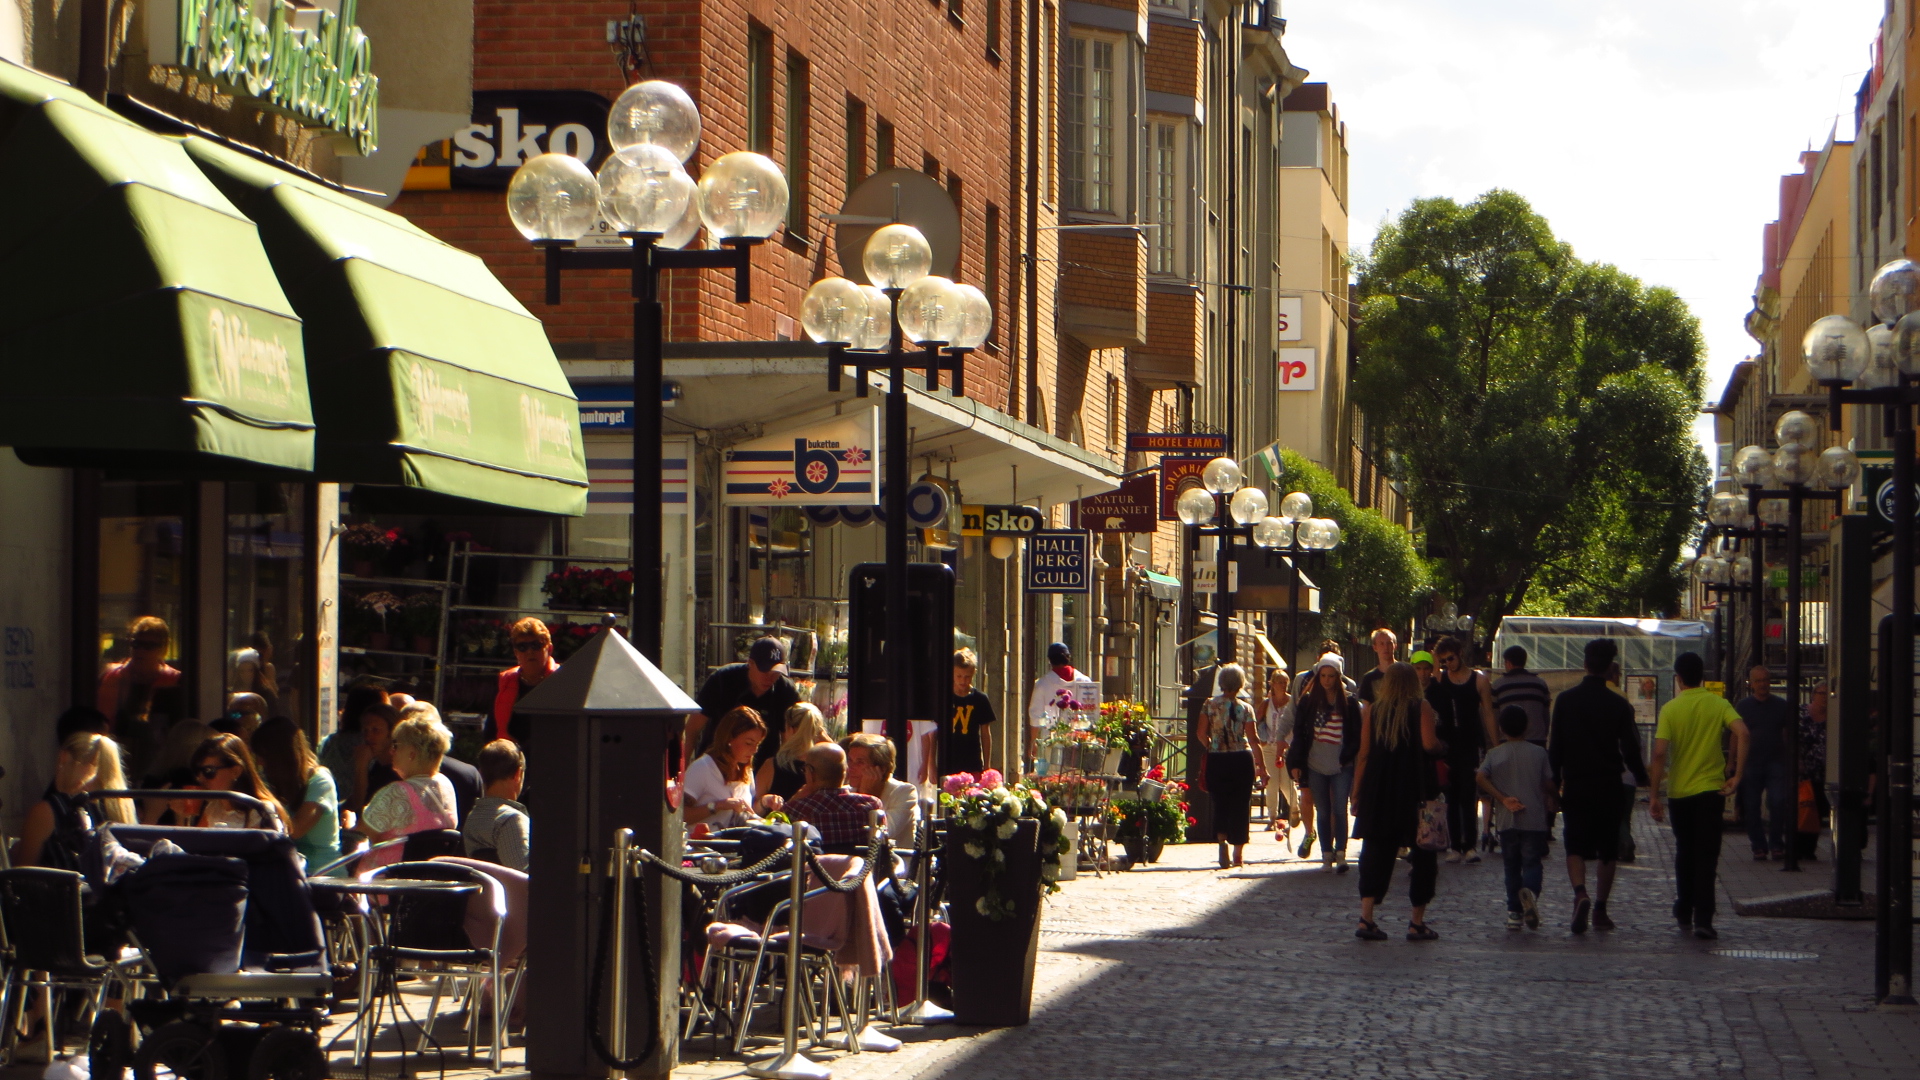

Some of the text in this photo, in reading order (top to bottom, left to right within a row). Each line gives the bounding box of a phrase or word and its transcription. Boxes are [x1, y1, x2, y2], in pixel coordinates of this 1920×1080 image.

[454, 108, 595, 168] sko
[580, 410, 625, 425] omtorget
[808, 440, 840, 449] buketten
[1149, 438, 1221, 448] HOTEL EMMA
[1094, 495, 1135, 504] NATUR
[1080, 505, 1150, 515] KOMPANIET
[985, 509, 1035, 532] sko
[1036, 539, 1080, 552] HALL
[1034, 571, 1081, 585] GULD
